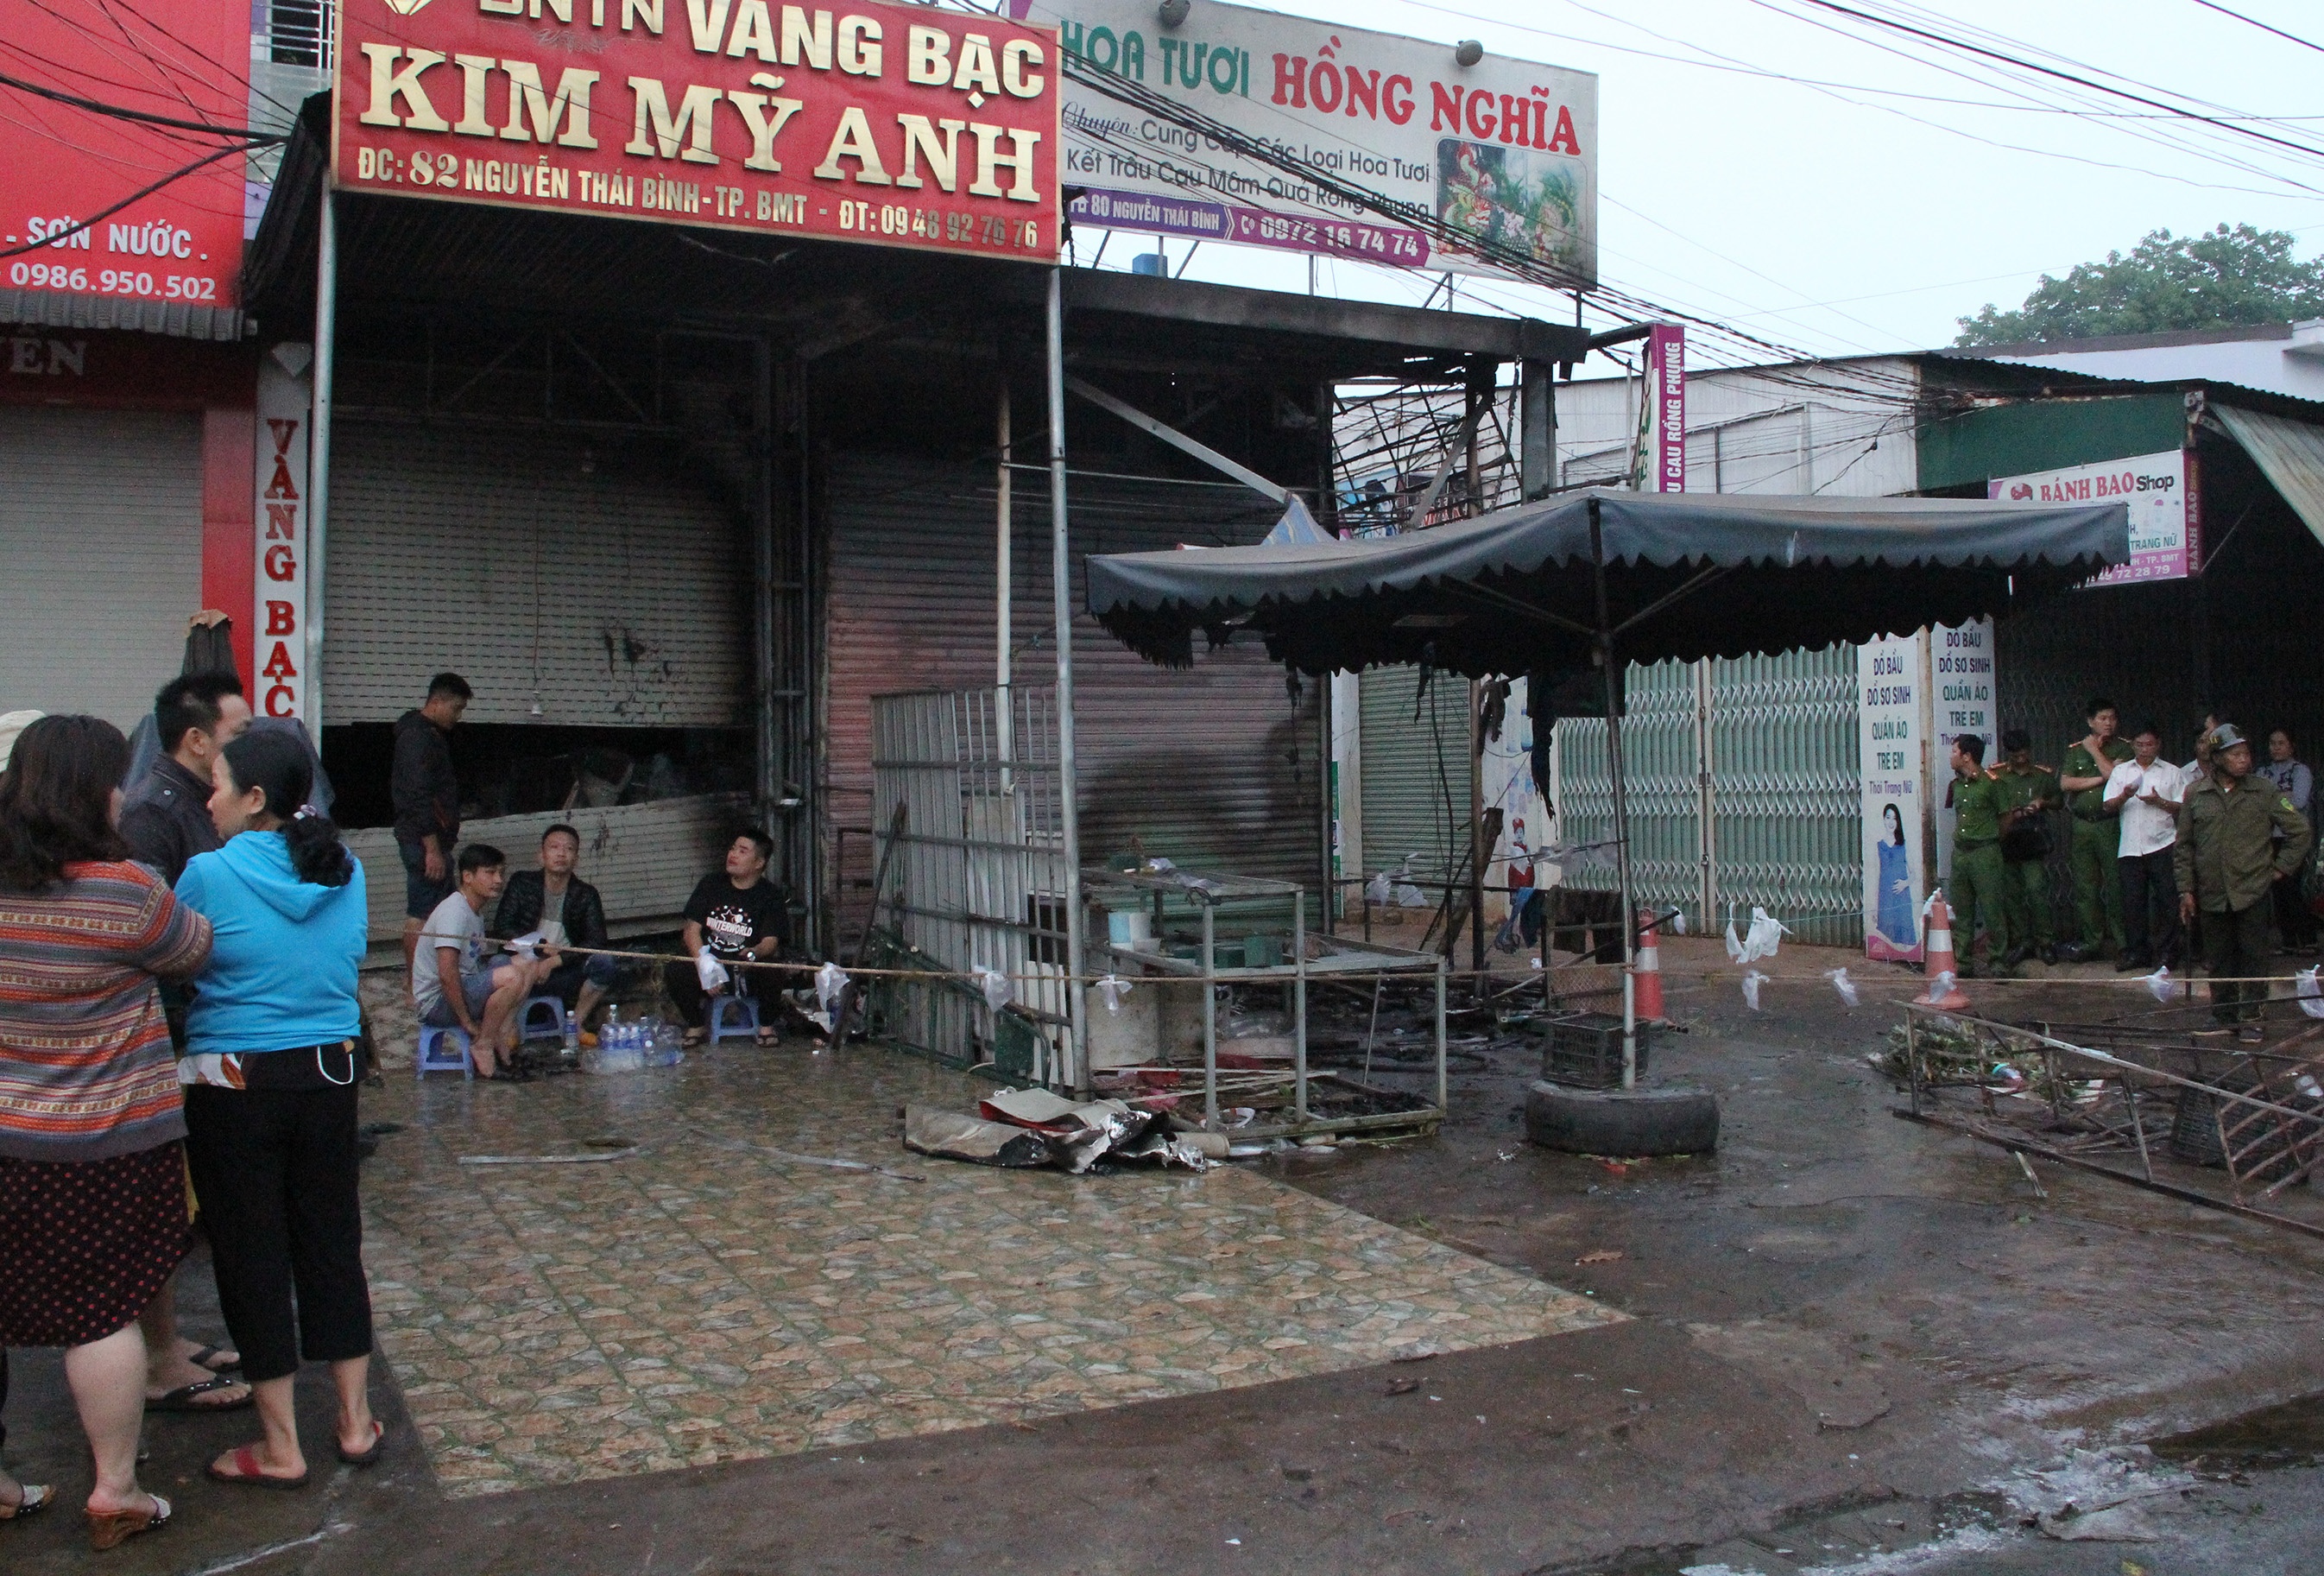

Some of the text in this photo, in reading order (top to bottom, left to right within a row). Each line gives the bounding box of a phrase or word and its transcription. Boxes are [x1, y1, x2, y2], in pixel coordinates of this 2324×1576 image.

[908, 24, 1045, 108] BẠC
[1060, 18, 1250, 98] HOA TƯƠI
[1271, 35, 1582, 156] HỒNG NGHĨA
[360, 42, 1042, 202] KIM MỸ ANH
[1141, 119, 1197, 153] Cung
[1304, 144, 1343, 174] Loại
[1349, 151, 1388, 175] Hoa
[1393, 159, 1430, 183] Tươi
[466, 155, 570, 199] NGUYỄN
[578, 168, 634, 206] THÁI
[757, 192, 807, 225] BMT
[1068, 148, 1102, 174] Kết
[1158, 161, 1201, 187] Cau
[1209, 168, 1260, 196] Mâm
[1090, 194, 1220, 231] 80 NGUYỄN THÁI BÌNH
[26, 215, 92, 250] SƠN
[1260, 217, 1418, 257] 0972 16 74 74
[10, 261, 217, 301] 0986.950.502
[1664, 341, 1684, 396] PHỤNG
[1667, 446, 1683, 478] CAU
[2040, 472, 2175, 502] BÁNH BAO Shop
[2188, 491, 2198, 523] BAO
[2131, 537, 2161, 551] TRANG
[1969, 657, 1991, 674] SINH
[1892, 686, 1910, 704] SINH
[1969, 711, 1984, 726] EM
[1892, 751, 1904, 769] EM
[1884, 781, 1902, 797] Trang
